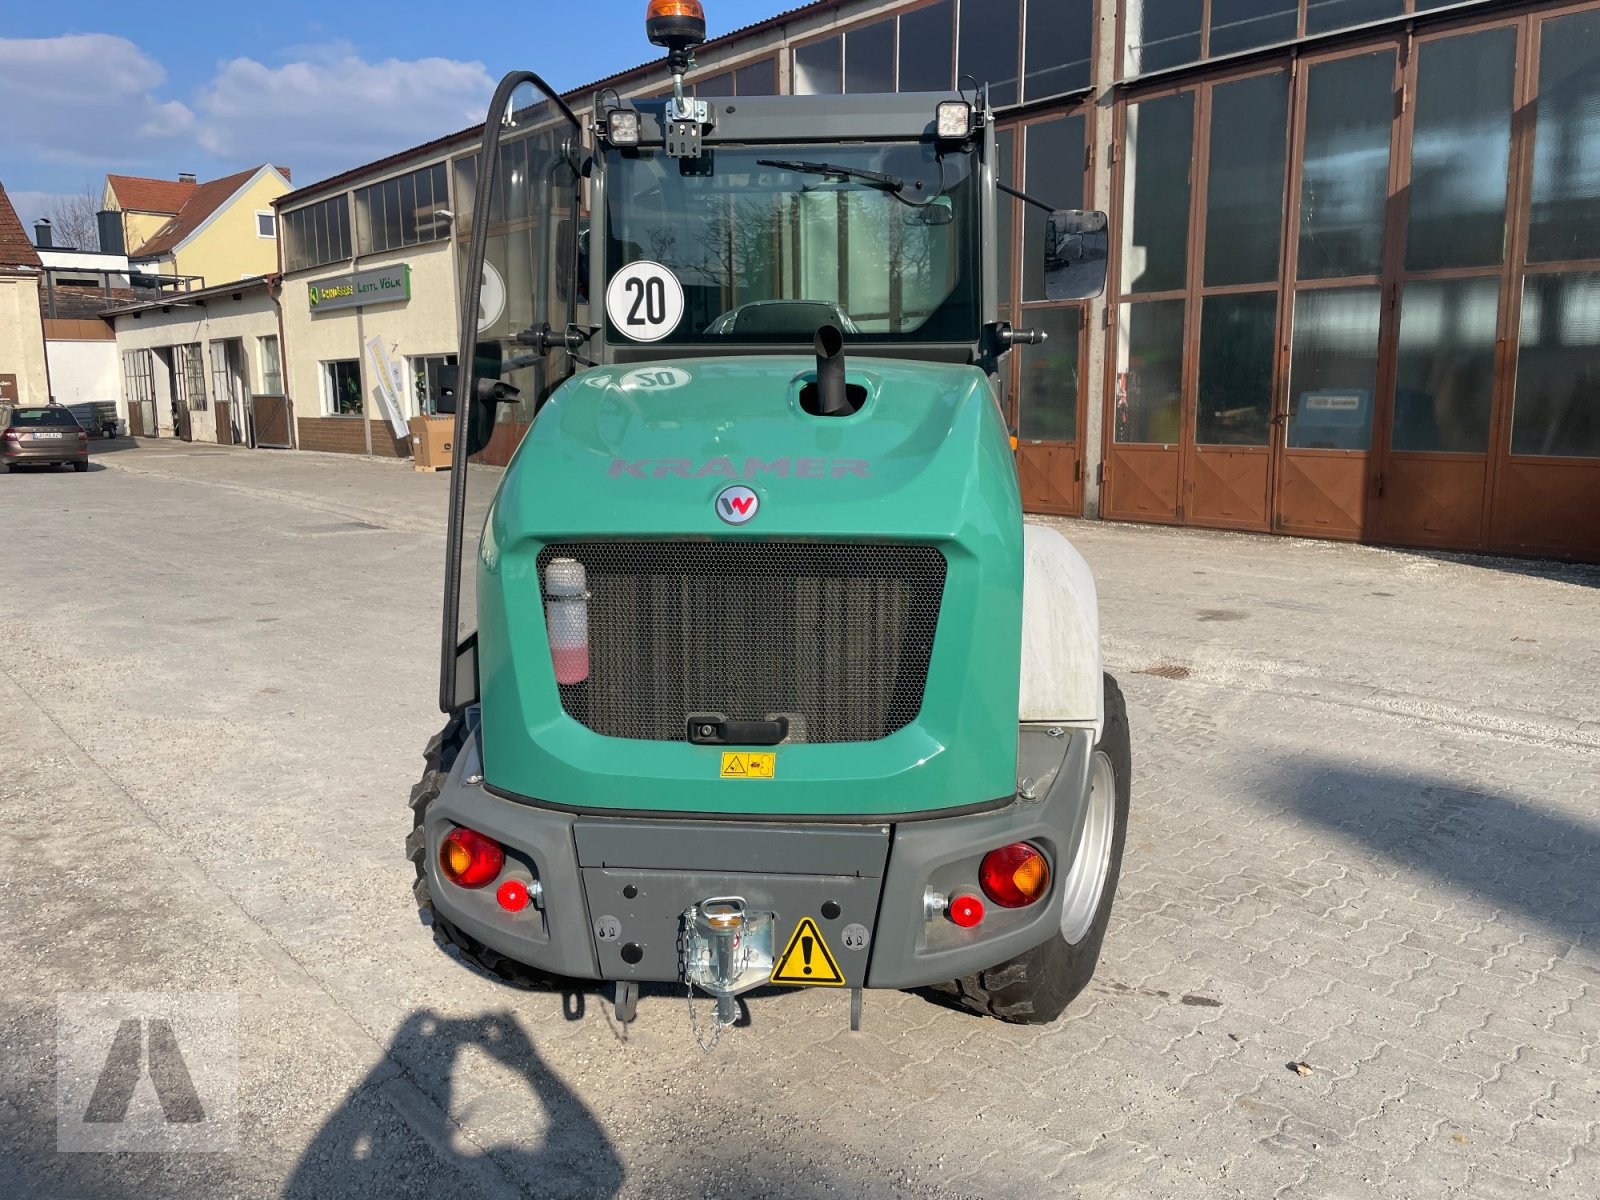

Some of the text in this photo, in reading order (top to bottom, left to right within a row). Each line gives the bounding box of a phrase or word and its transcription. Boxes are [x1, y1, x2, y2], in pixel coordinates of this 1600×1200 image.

[357, 282, 379, 293] LEITL
[625, 276, 666, 325] 20
[607, 457, 873, 479] KRAMER
